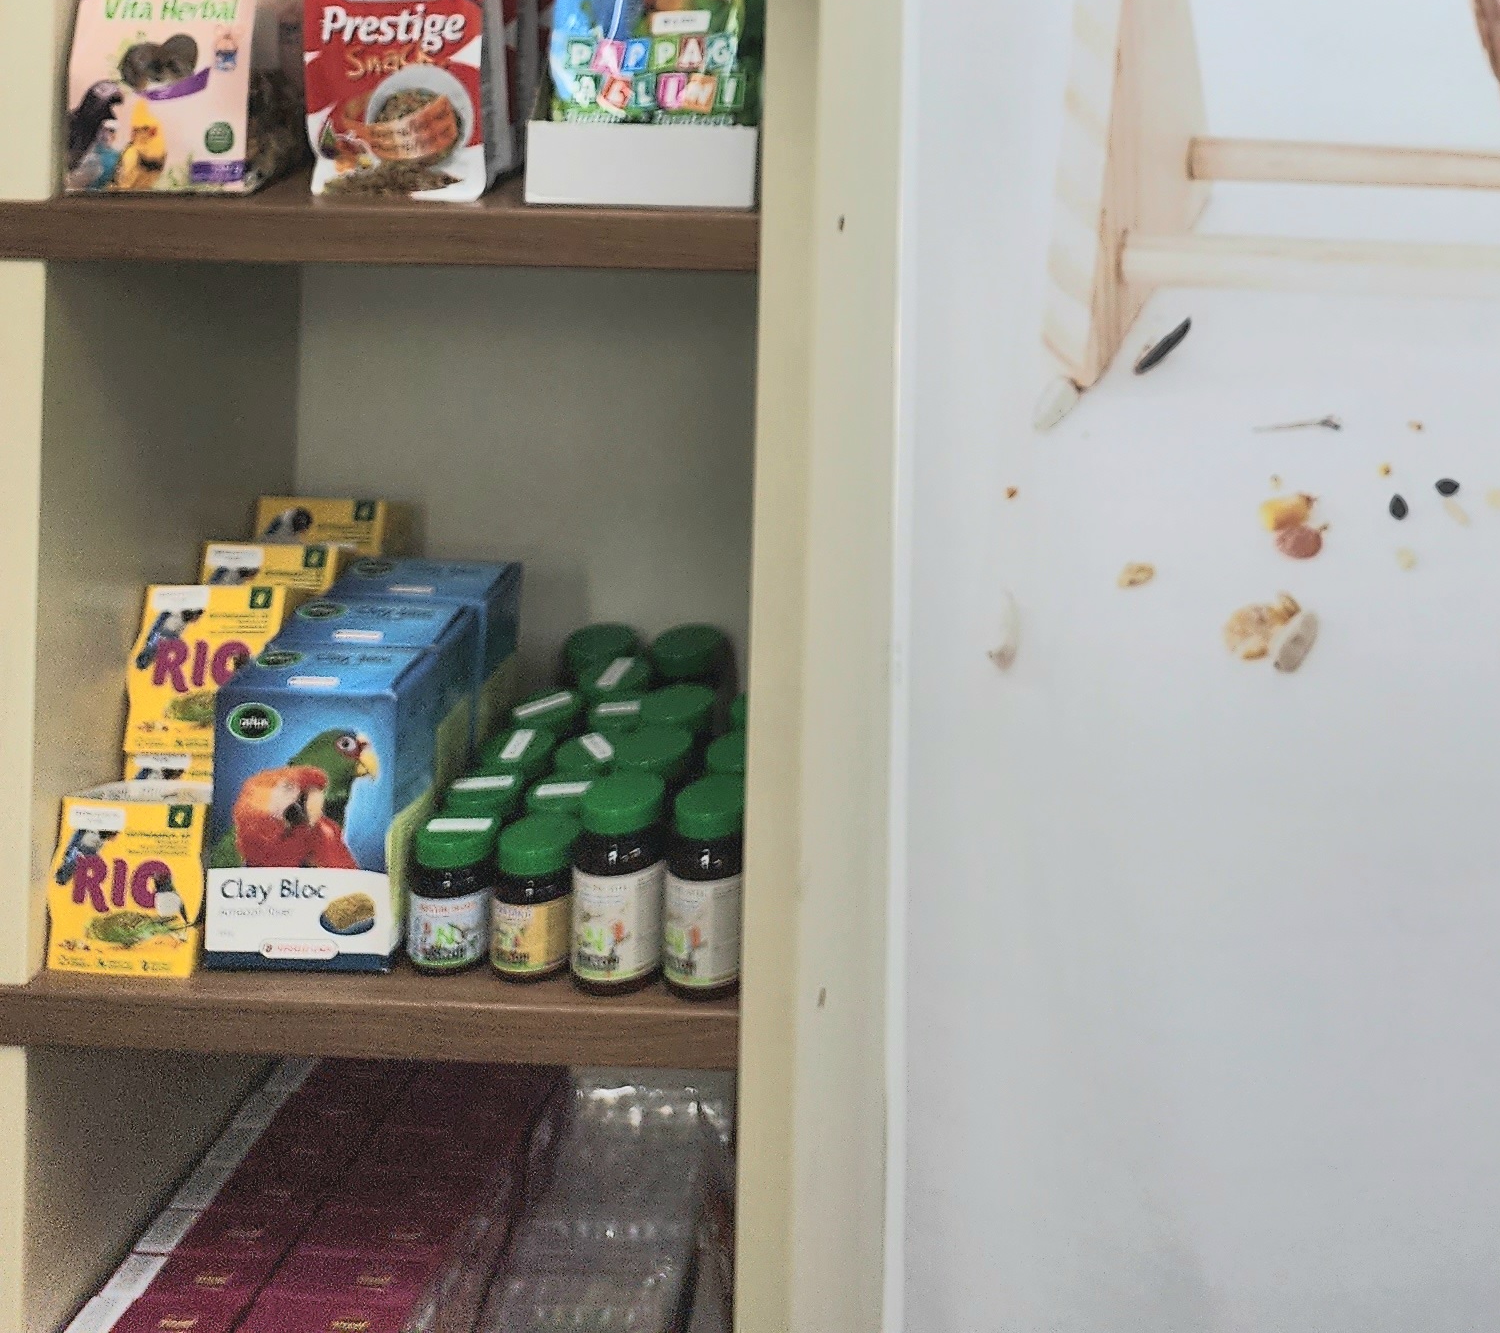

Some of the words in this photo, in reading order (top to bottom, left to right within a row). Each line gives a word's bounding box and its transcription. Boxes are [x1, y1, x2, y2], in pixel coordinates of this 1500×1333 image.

[319, 3, 466, 55] Prestige
[152, 637, 251, 693] RIO
[72, 853, 173, 913] RIO
[220, 877, 272, 905] Clay
[279, 878, 327, 900] Bloc
